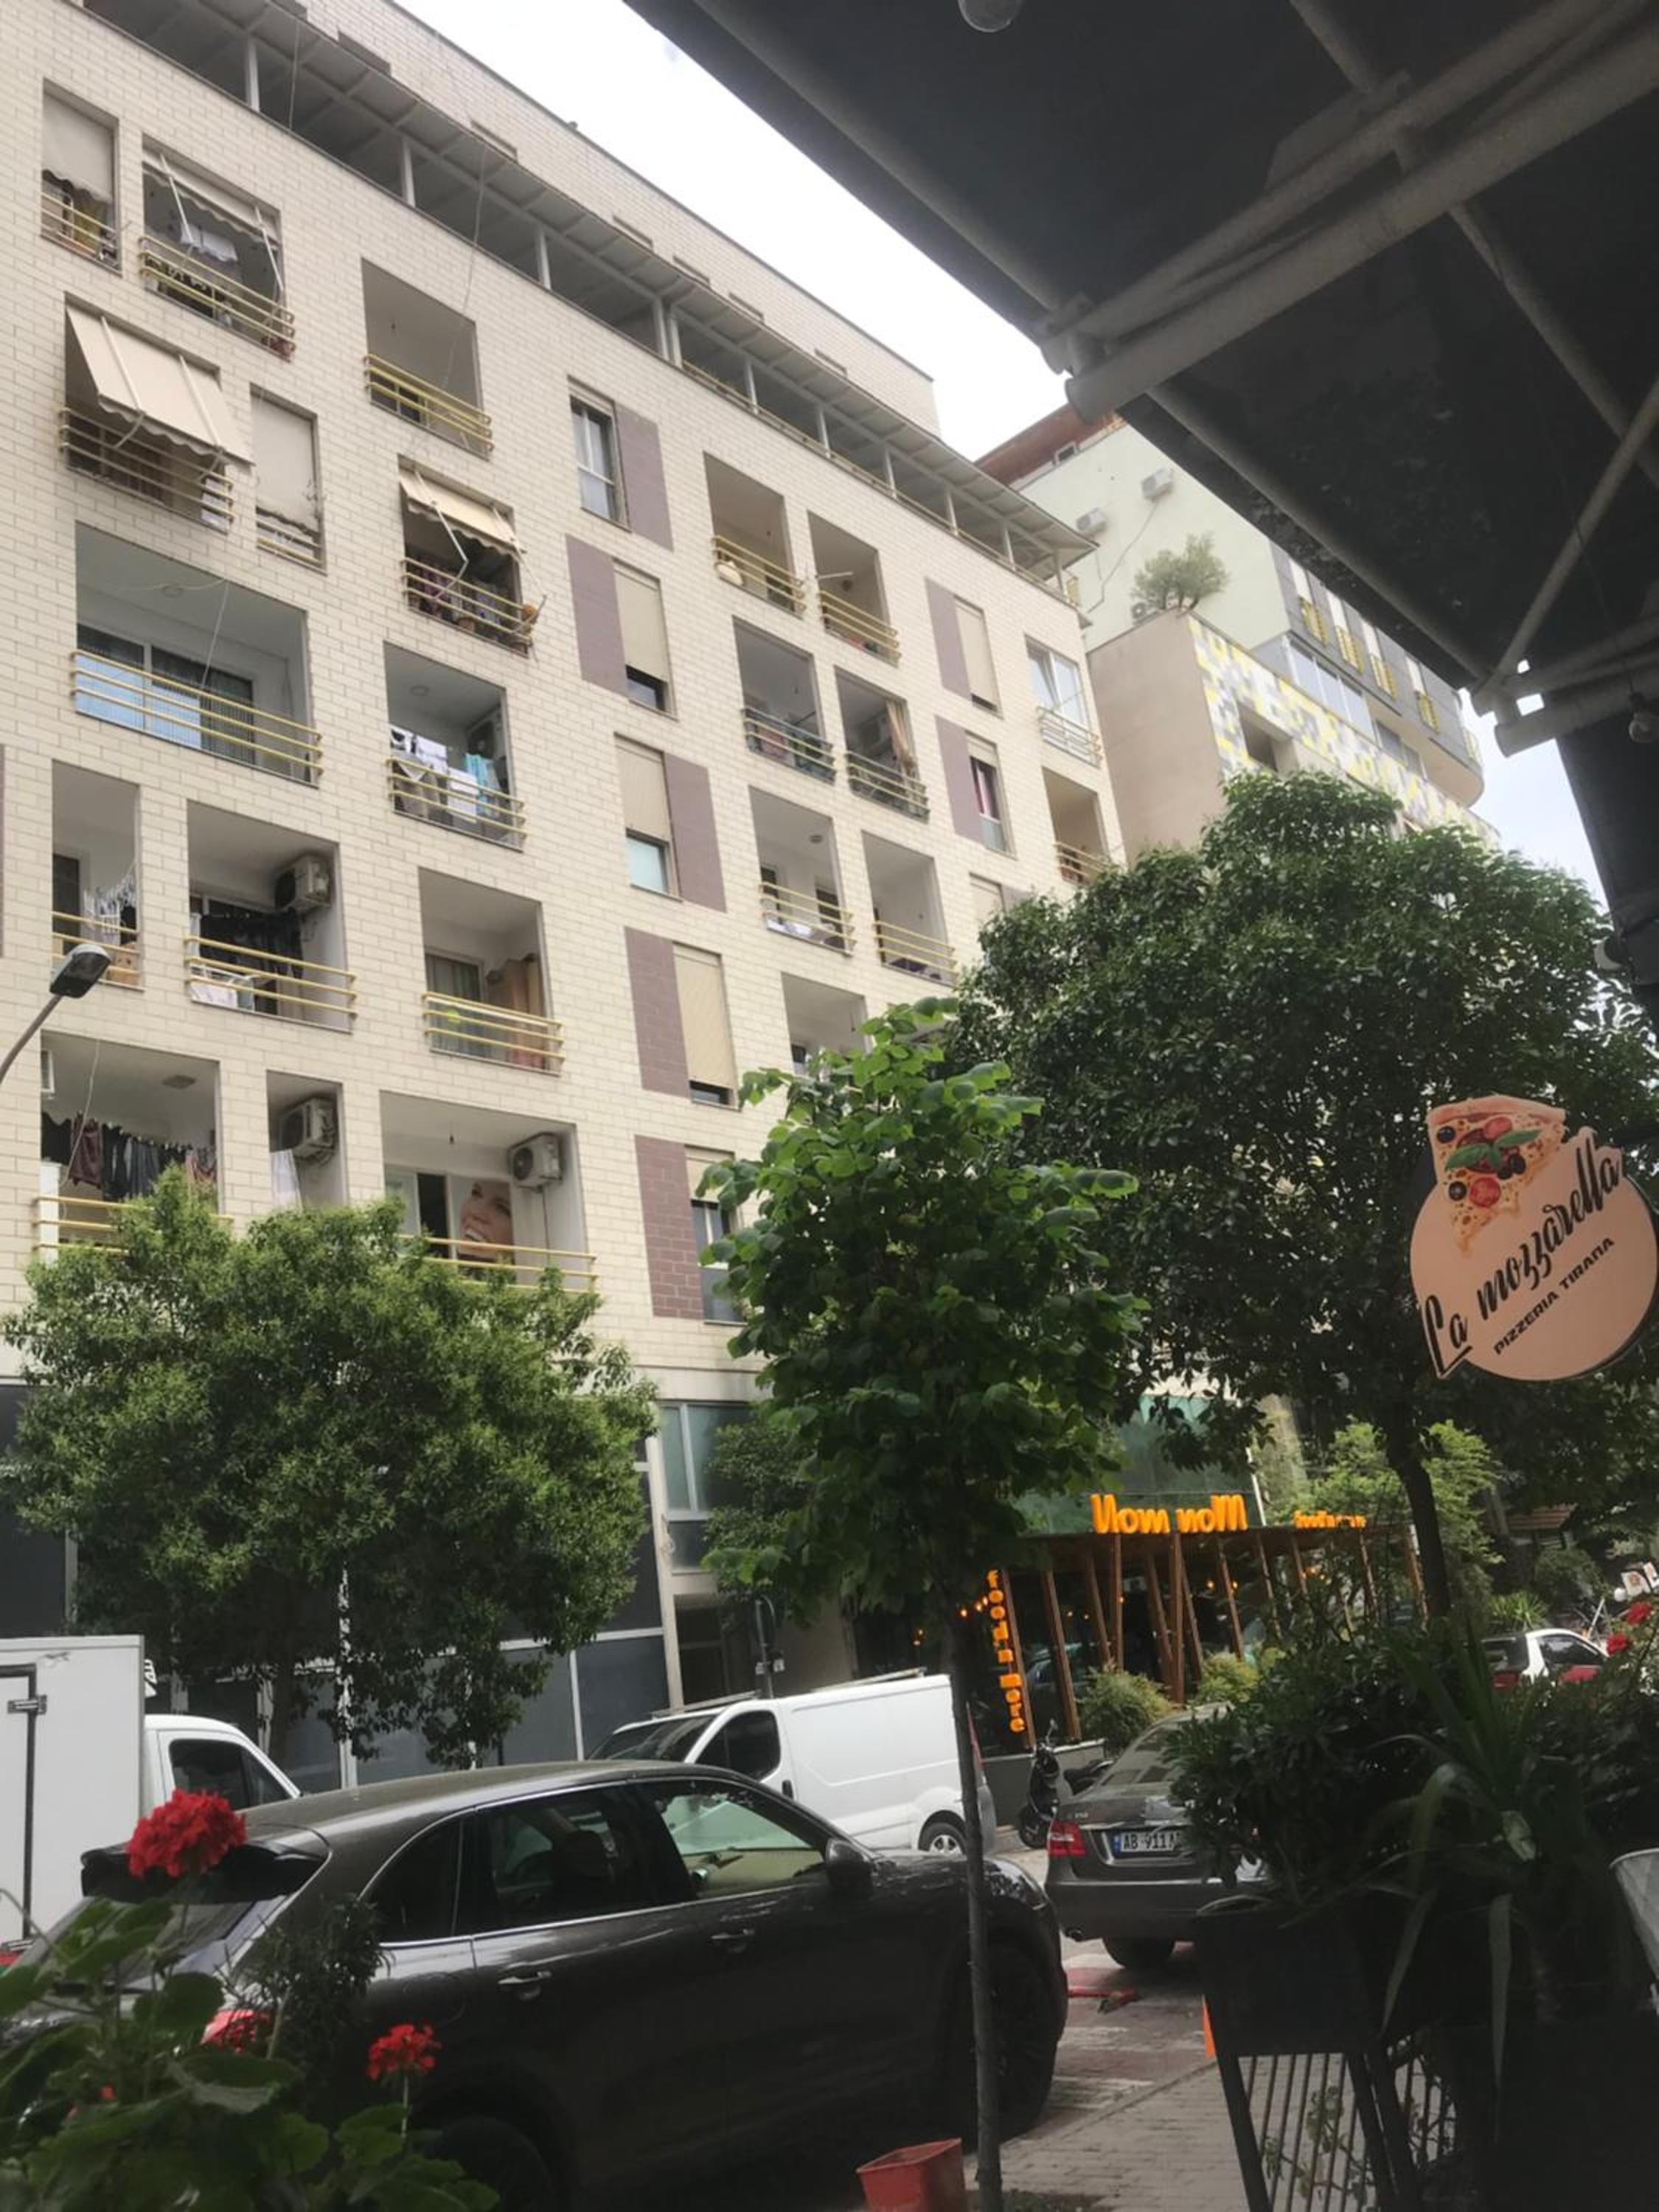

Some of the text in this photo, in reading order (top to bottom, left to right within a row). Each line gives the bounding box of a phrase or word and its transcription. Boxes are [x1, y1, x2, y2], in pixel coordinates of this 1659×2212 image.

[1425, 1137, 1620, 1376] La mozzarella
[1494, 1237, 1615, 1355] PIZZERIA TIRANA
